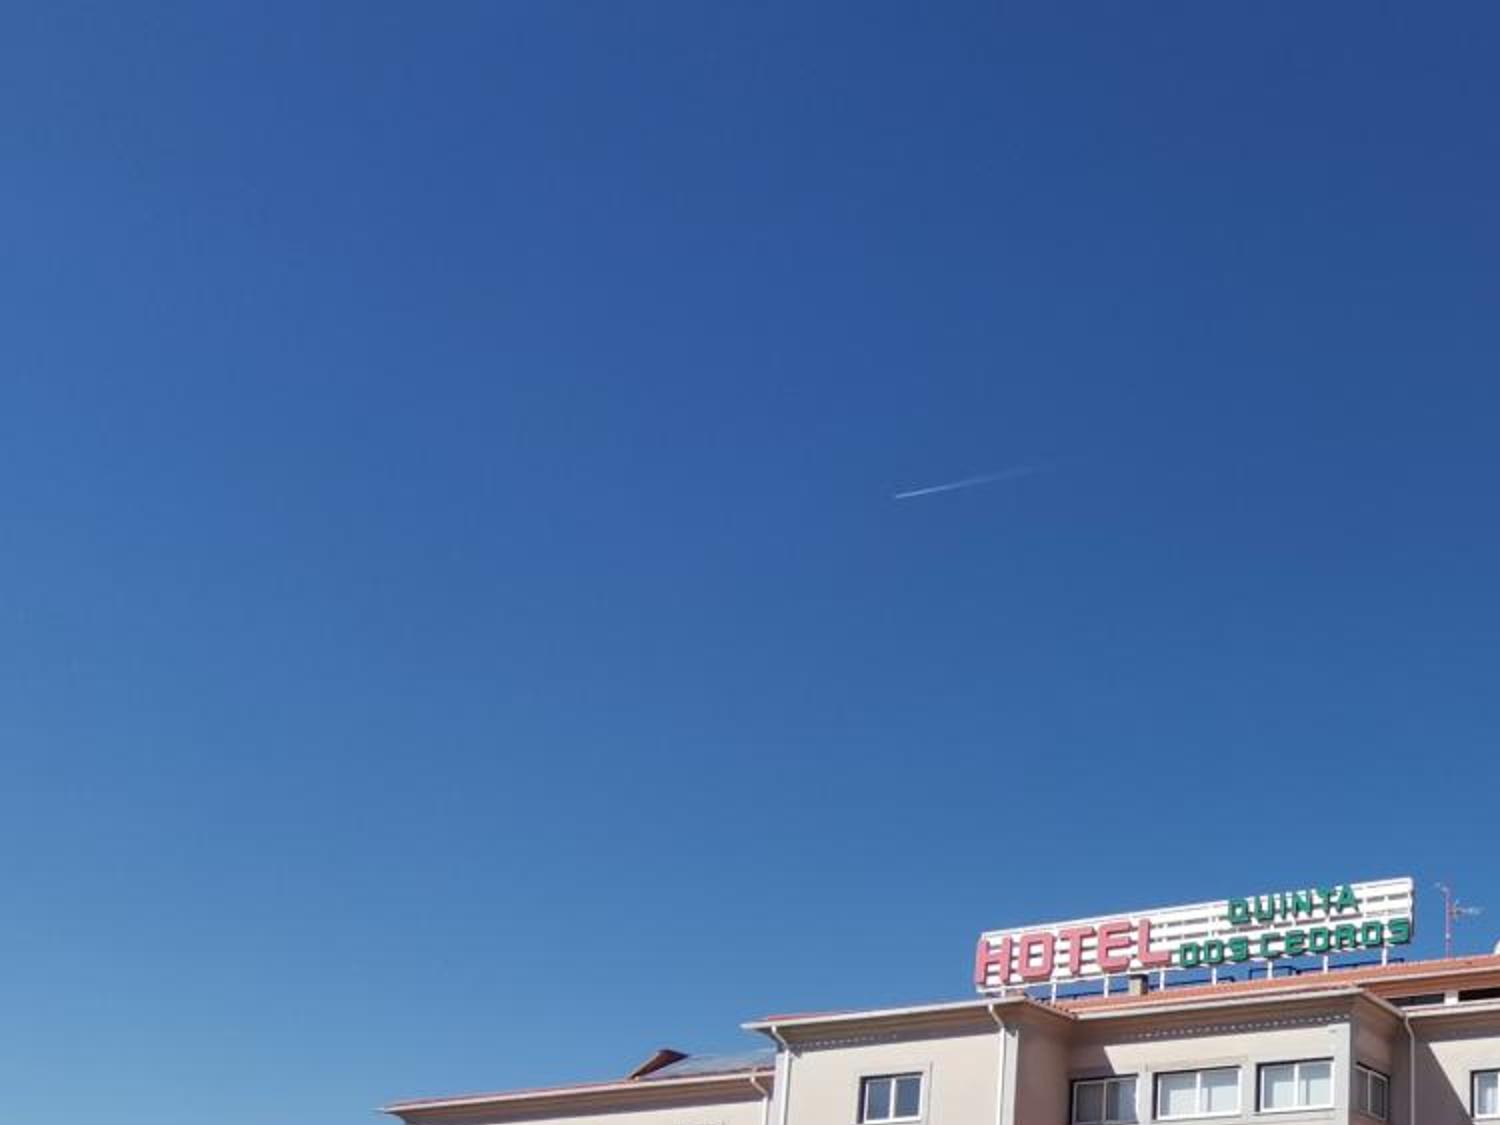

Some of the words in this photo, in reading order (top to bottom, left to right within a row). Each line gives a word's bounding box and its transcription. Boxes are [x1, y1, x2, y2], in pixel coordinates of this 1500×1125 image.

[1228, 885, 1360, 924] QUINTA
[975, 918, 1172, 985] HOTEL
[1180, 936, 1250, 968] DOS
[1260, 918, 1410, 959] CEDROS
